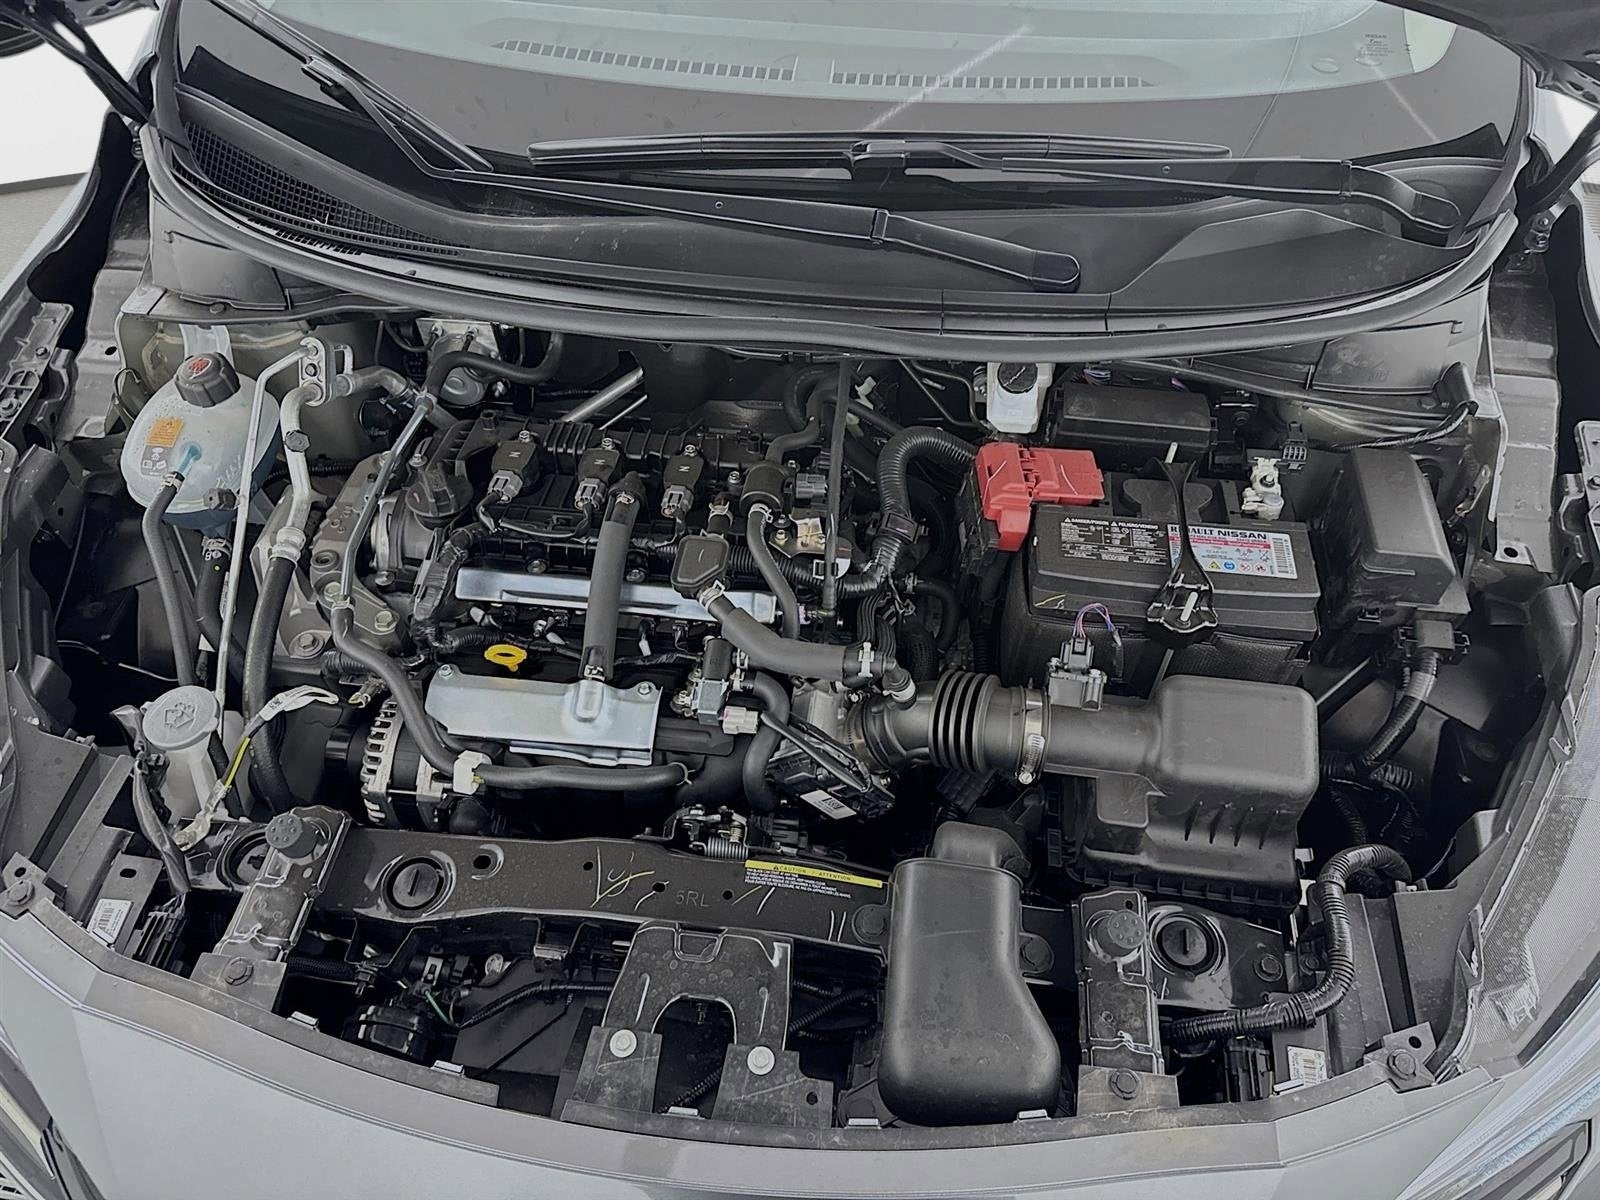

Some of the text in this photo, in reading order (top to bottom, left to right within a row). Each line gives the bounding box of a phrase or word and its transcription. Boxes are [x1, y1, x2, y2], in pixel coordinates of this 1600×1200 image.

[1170, 525, 1215, 536] RAULT
[1217, 529, 1267, 540] NISSAN
[780, 865, 807, 874] CAUTION
[818, 871, 851, 881] ATTENTION
